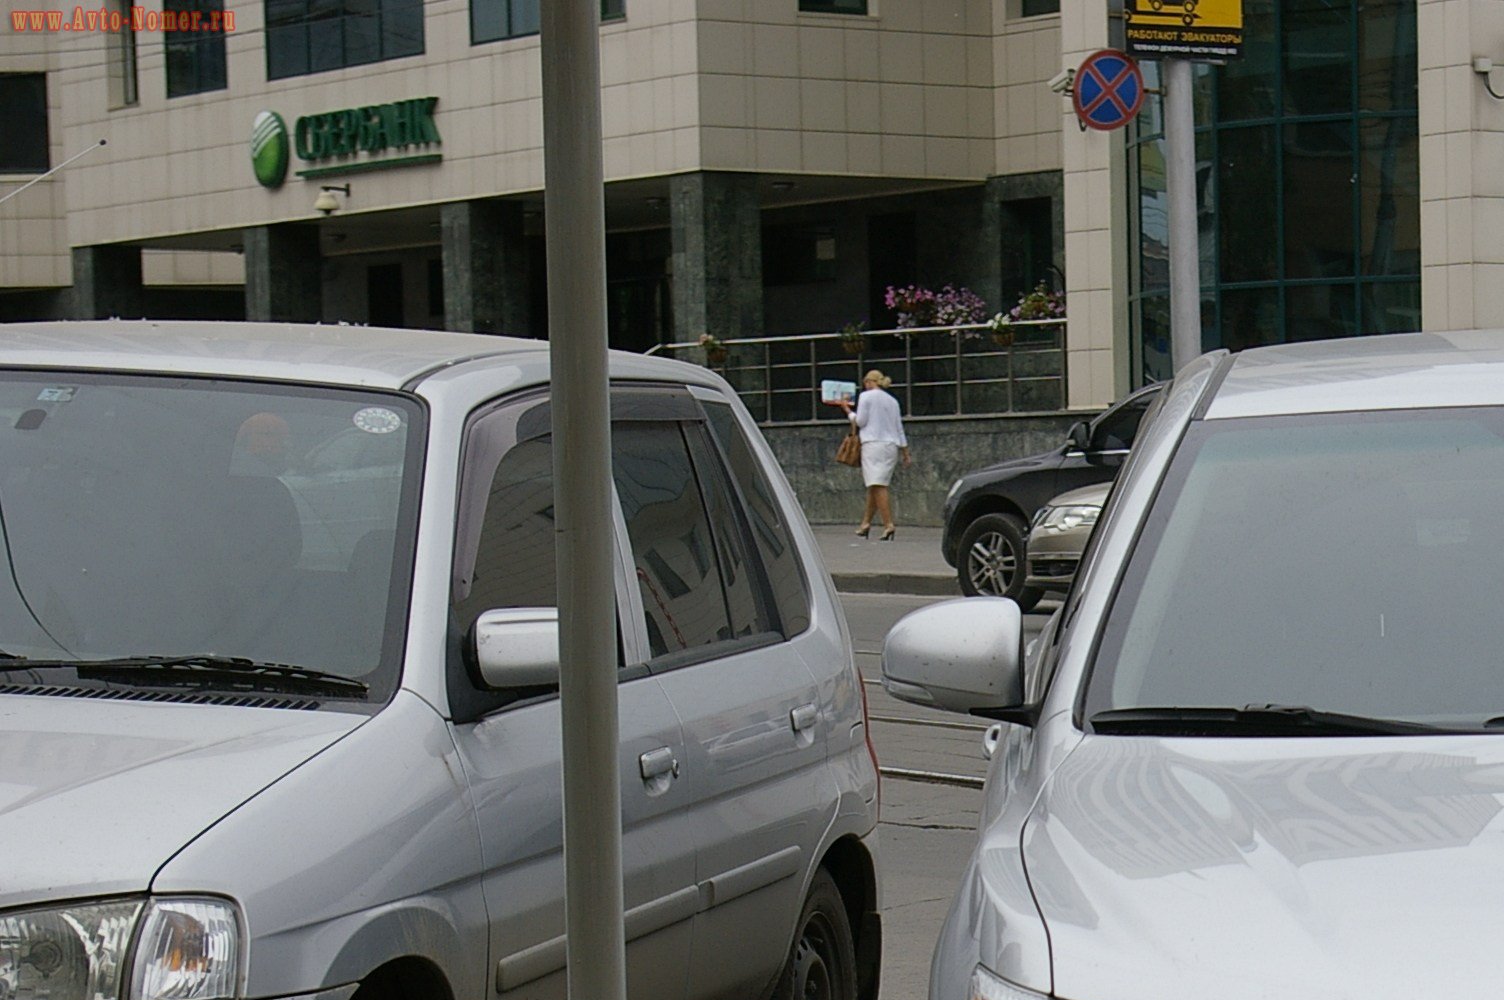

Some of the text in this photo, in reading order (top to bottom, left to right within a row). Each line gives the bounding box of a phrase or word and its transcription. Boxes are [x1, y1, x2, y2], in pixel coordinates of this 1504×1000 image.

[1127, 29, 1242, 44] РАБОТАЮТ ЭВАКУАТОРЫ
[296, 97, 441, 161] СБЕРБАНК
